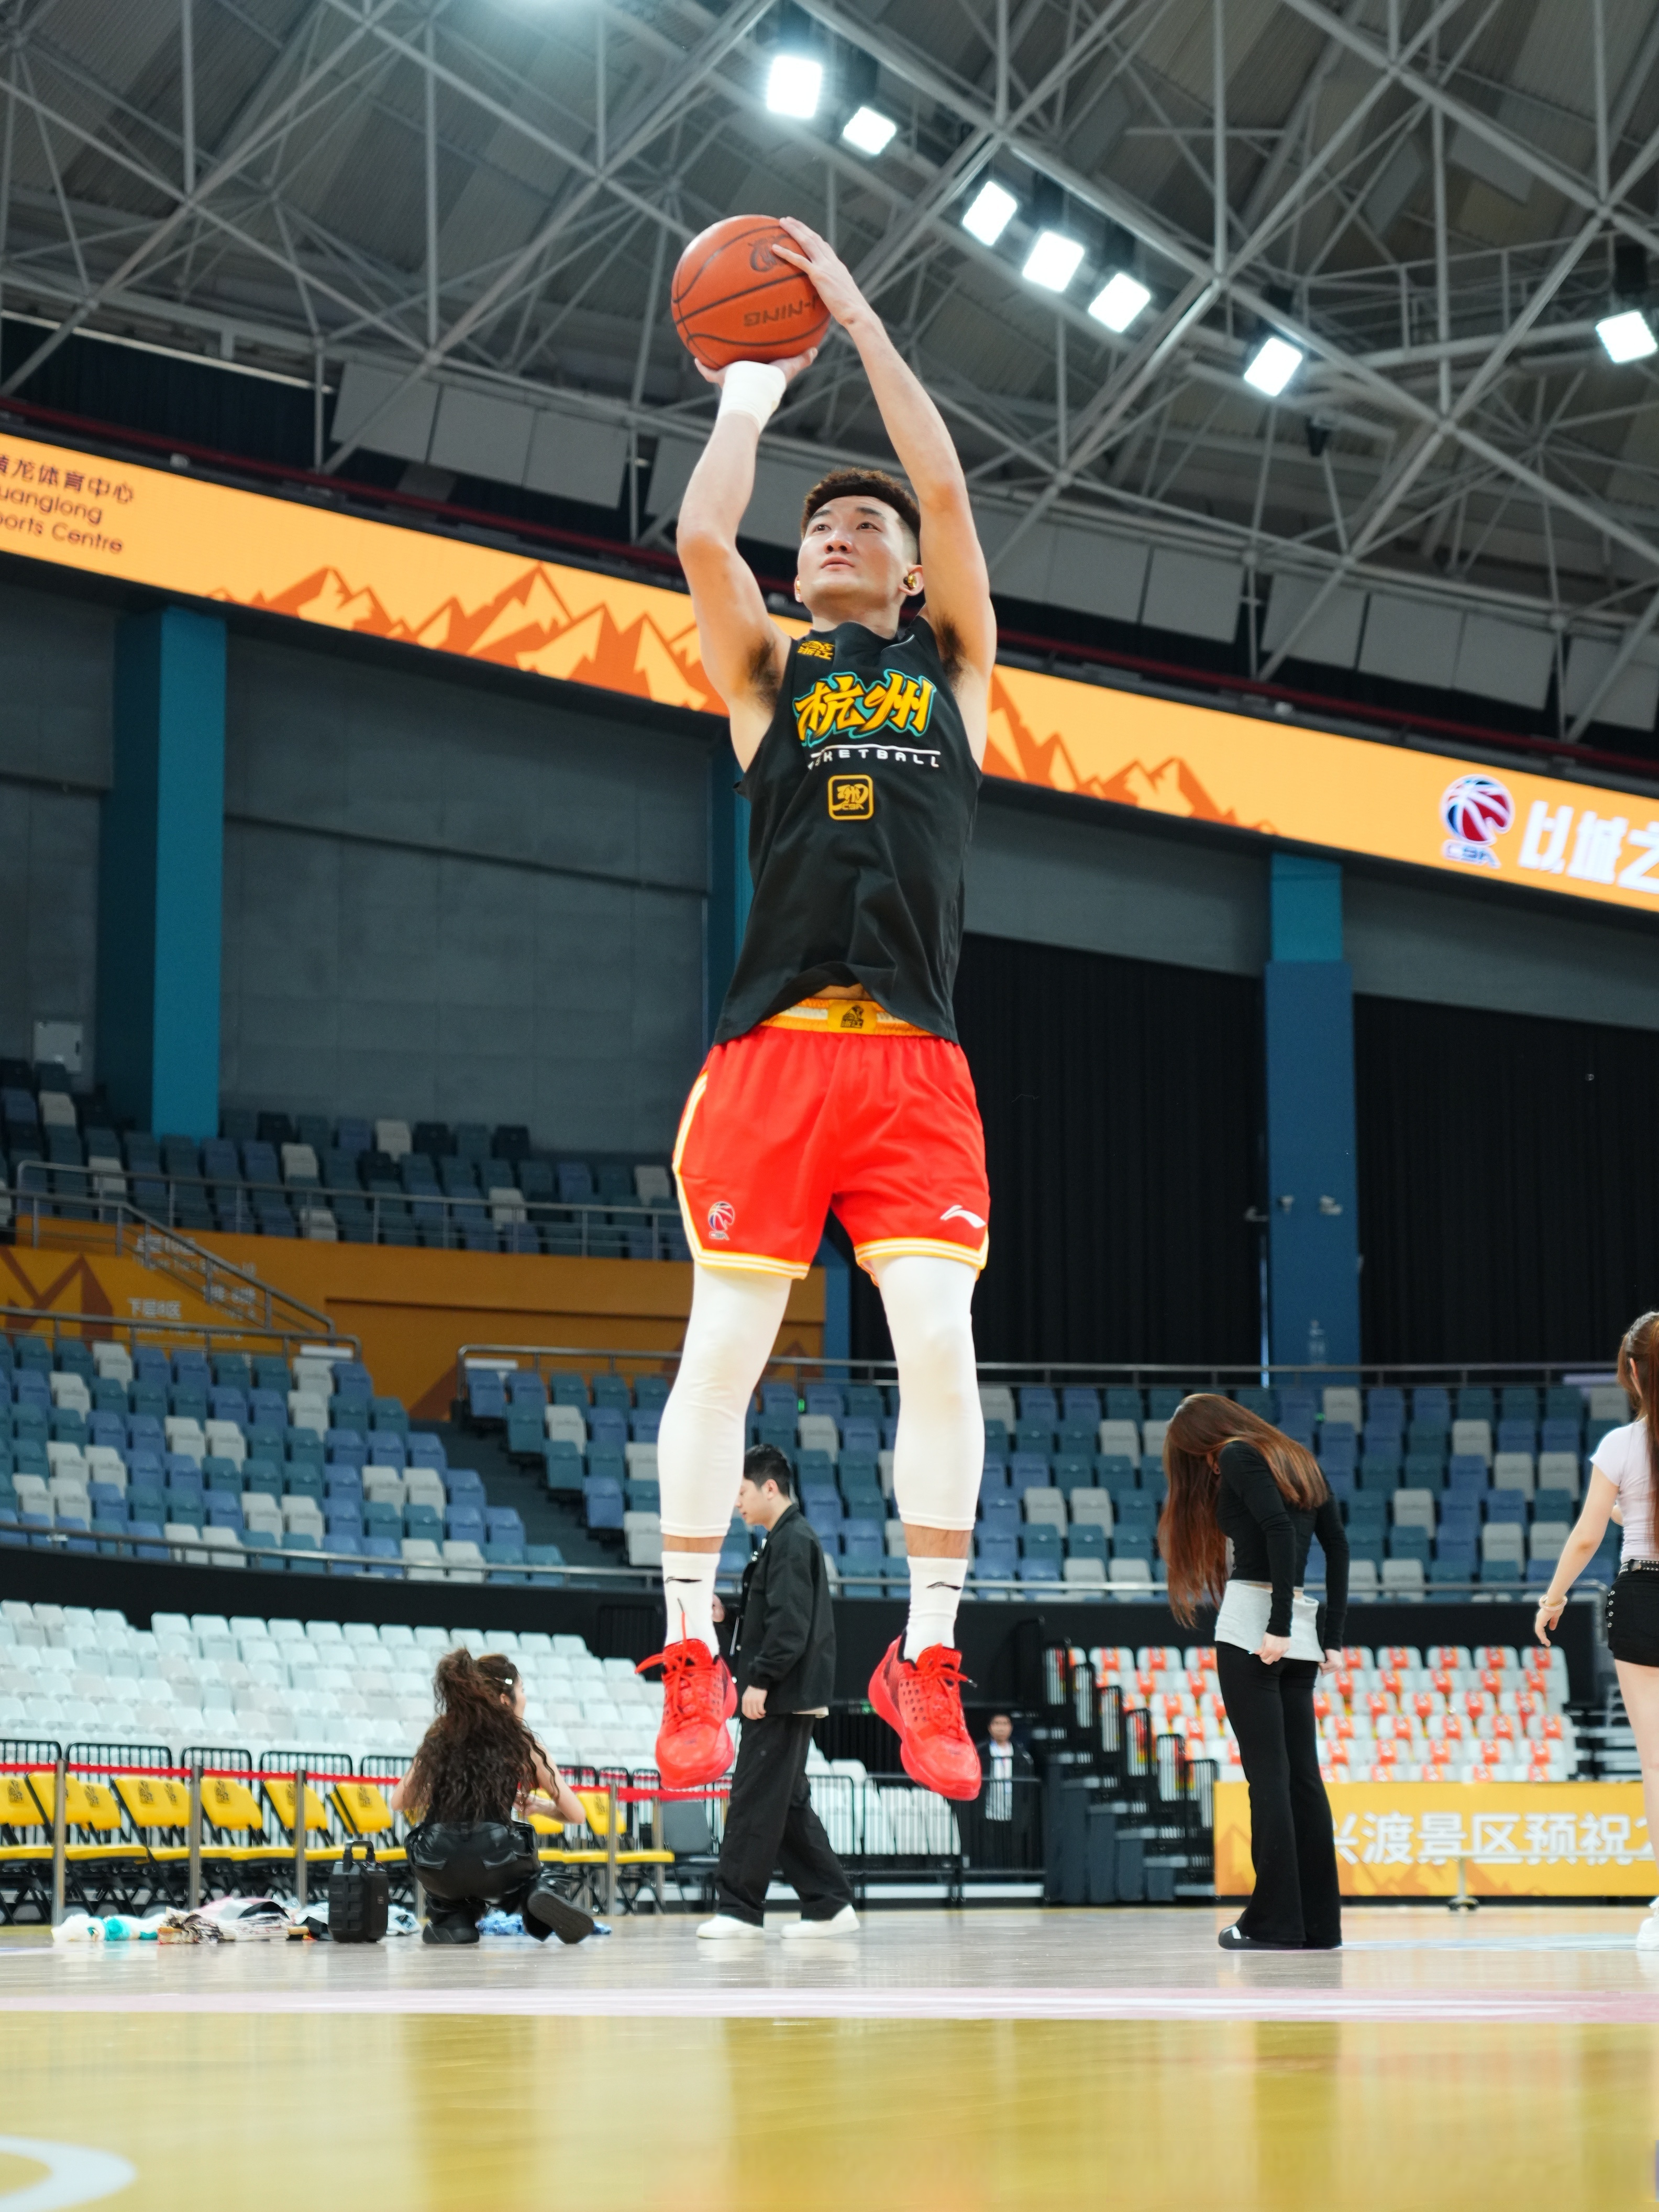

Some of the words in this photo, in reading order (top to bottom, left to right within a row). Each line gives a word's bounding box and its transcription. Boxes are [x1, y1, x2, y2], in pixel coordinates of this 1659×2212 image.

[744, 294, 820, 326] I-NING
[0, 513, 44, 537] orts
[51, 521, 124, 554] Centre
[793, 669, 937, 747] 杭州
[1444, 839, 1501, 869] CBA
[1518, 800, 1659, 894] 以城之
